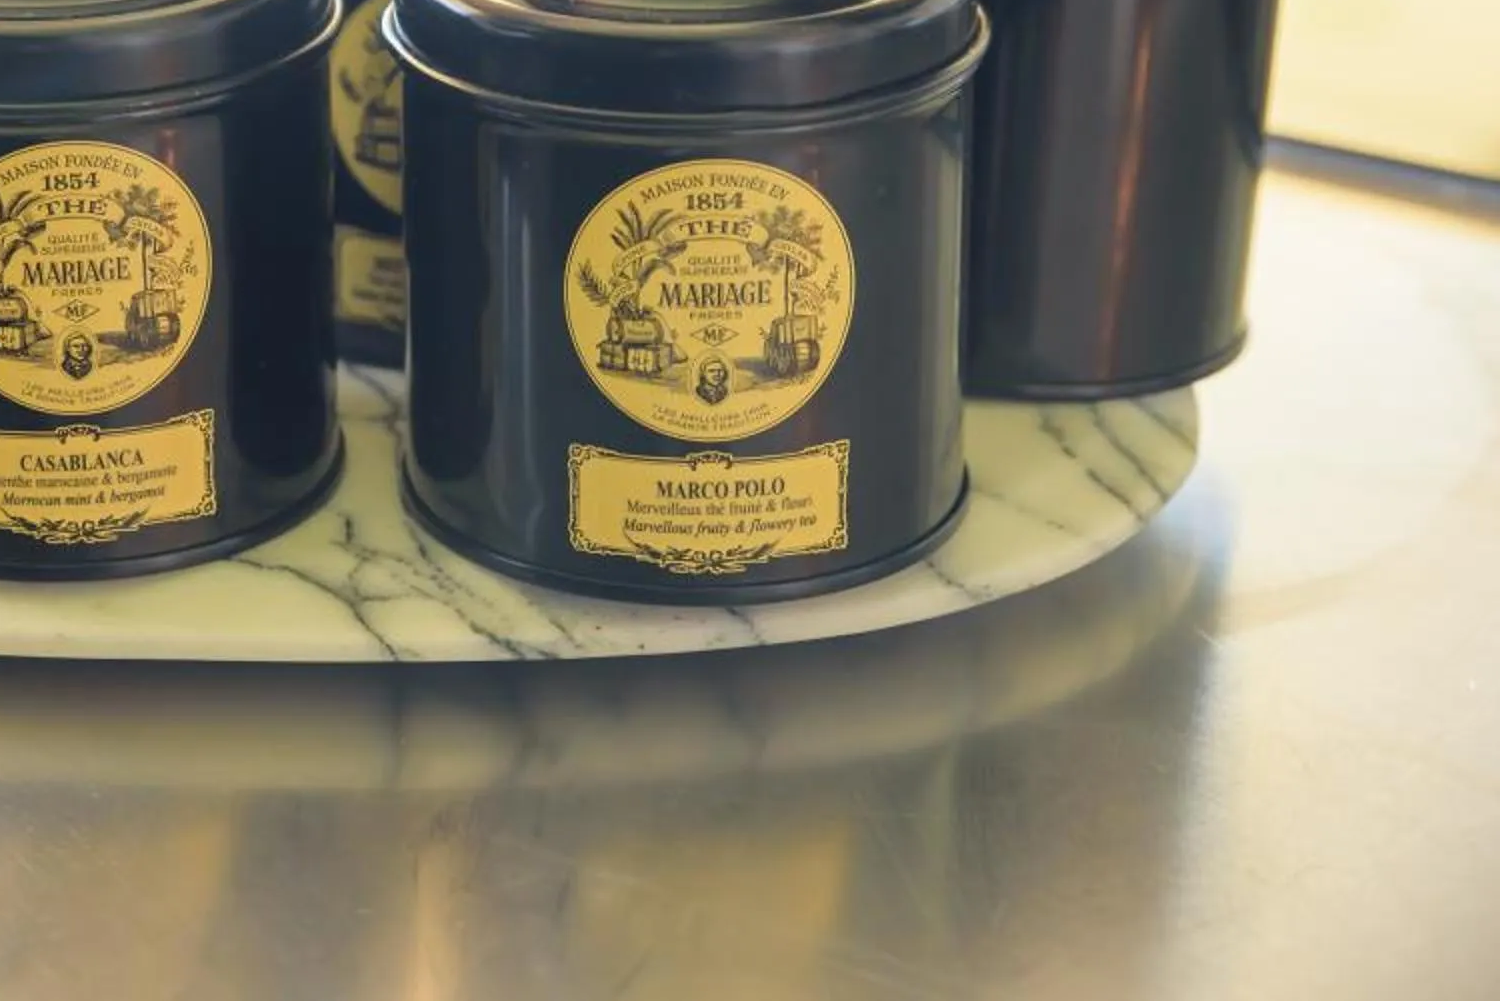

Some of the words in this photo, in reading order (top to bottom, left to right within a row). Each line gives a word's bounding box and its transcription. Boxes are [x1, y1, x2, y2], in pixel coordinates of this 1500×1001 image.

[0, 155, 59, 185] MAISON
[123, 162, 143, 179] EN
[43, 171, 100, 192] 1854
[640, 173, 704, 203] MAISON
[768, 183, 791, 200] EN
[685, 192, 747, 211] 1854
[21, 257, 132, 287] MARIAGE
[658, 279, 773, 309] MARIAGE
[20, 449, 145, 472] CASABLANCA
[101, 472, 113, 486] &
[656, 480, 729, 500] MARCO
[734, 477, 785, 497] POLO
[65, 493, 93, 505] mint
[95, 491, 107, 504] &
[110, 486, 166, 504] bergamot
[765, 499, 777, 512] &
[624, 517, 693, 534] Marvellous
[694, 520, 730, 538] fruity
[734, 519, 746, 534] &
[748, 516, 797, 537] flowery
[799, 514, 818, 527] tea
